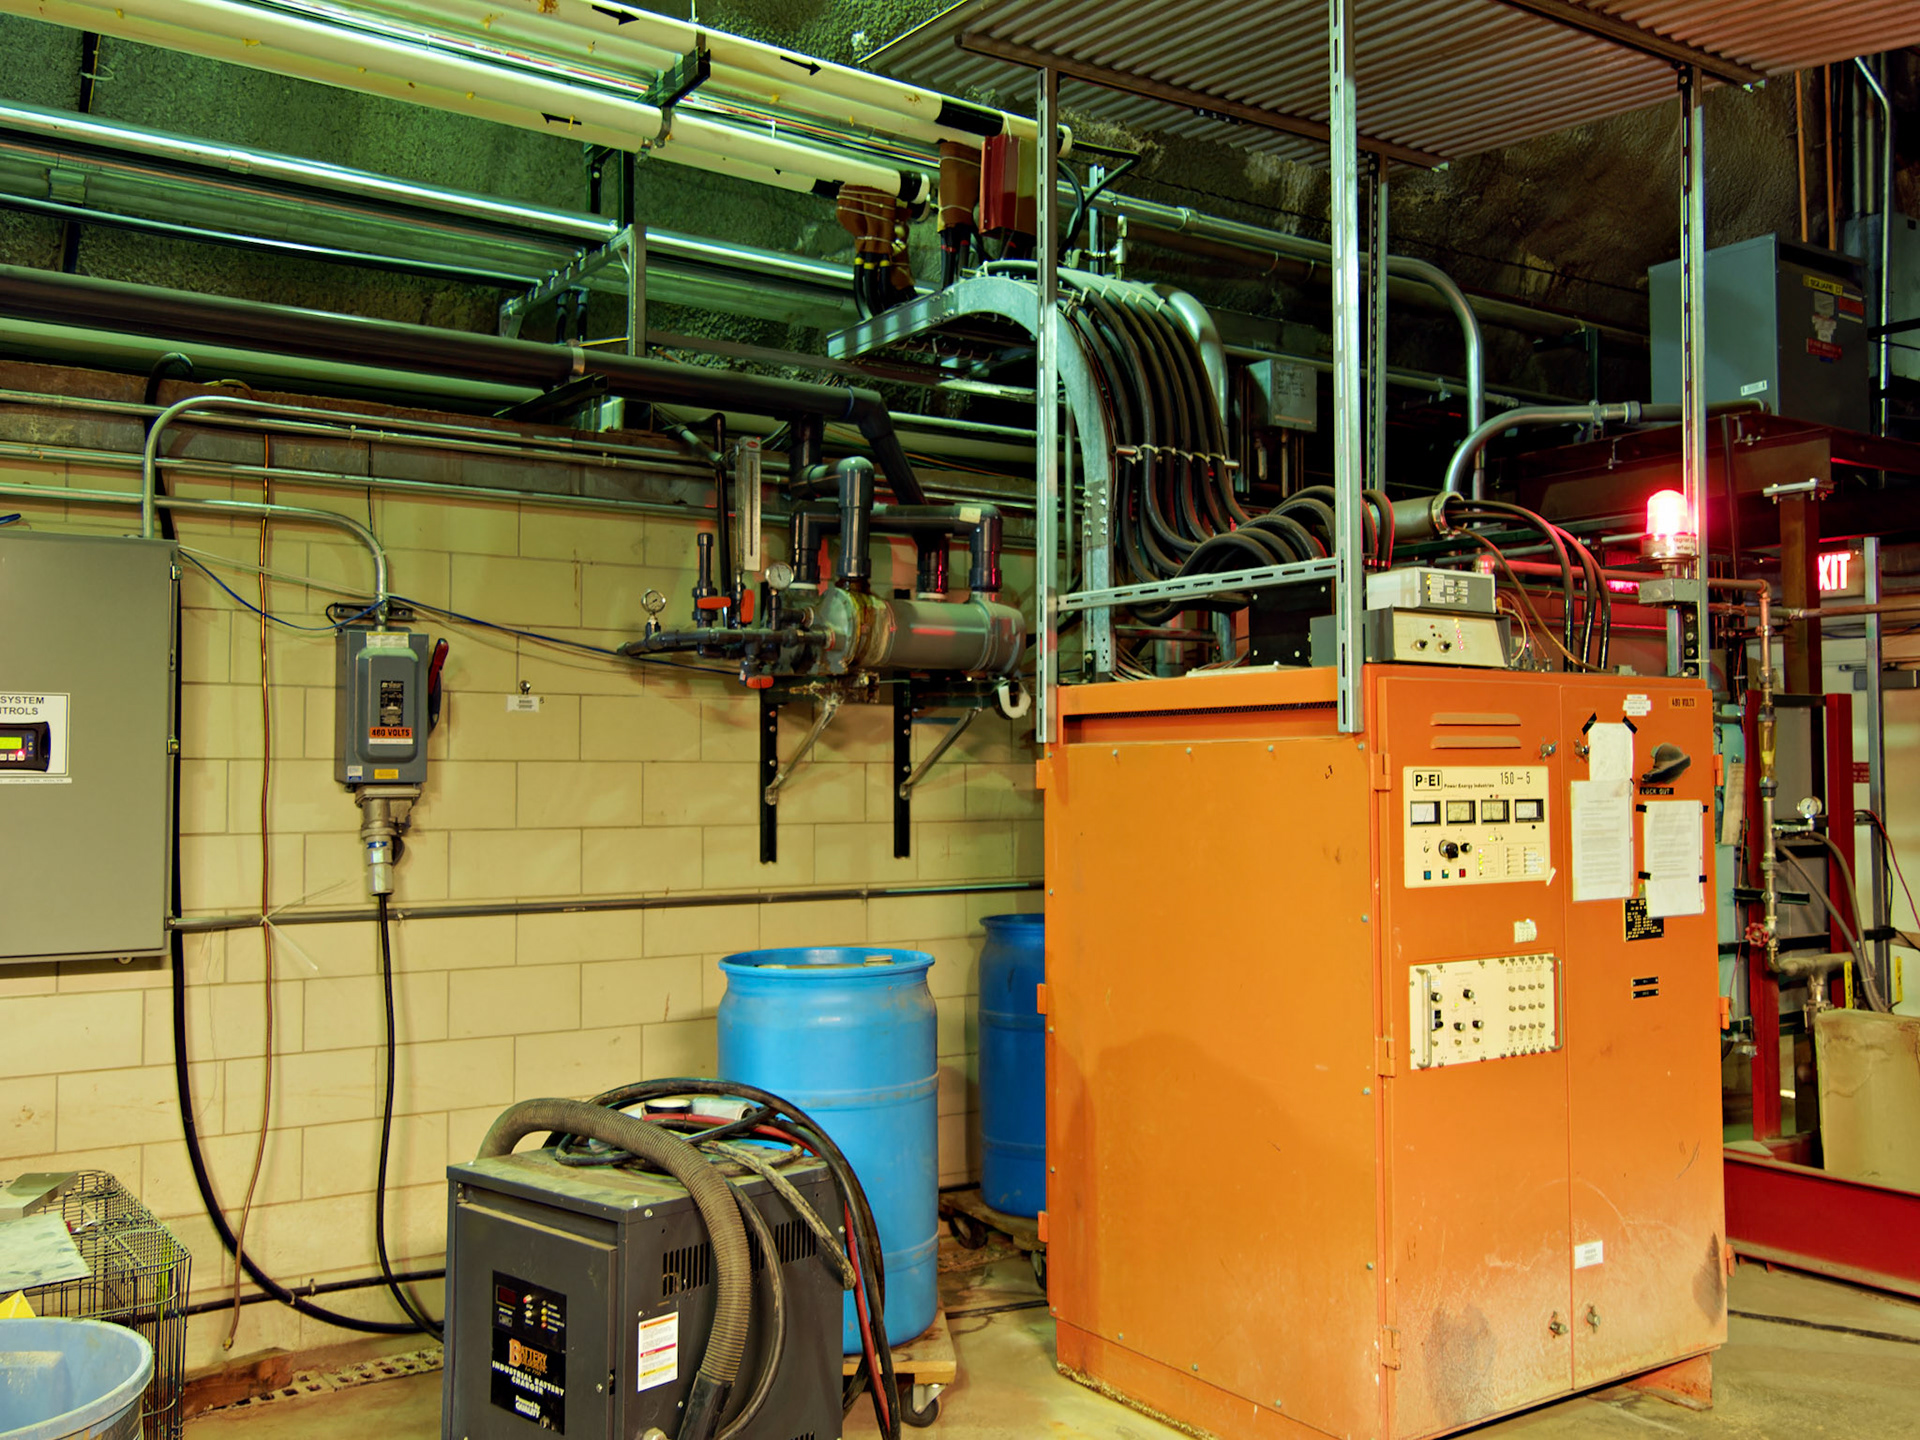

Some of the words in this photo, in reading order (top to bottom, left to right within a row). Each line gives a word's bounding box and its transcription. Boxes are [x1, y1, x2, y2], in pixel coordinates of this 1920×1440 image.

[1818, 553, 1851, 590] XIT
[0, 695, 45, 705] SYSTEM
[1682, 697, 1695, 707] VOLTS
[0, 706, 39, 716] TROLS
[371, 728, 386, 737] 480
[387, 728, 411, 737] VOLTS
[1641, 787, 1657, 795] LOCK
[1658, 787, 1671, 795] OUT
[508, 1338, 548, 1368] BATTERY
[492, 1360, 533, 1383] INDUSTRIAL
[534, 1377, 565, 1397] BATTERY
[511, 1376, 544, 1396] CHARGER
